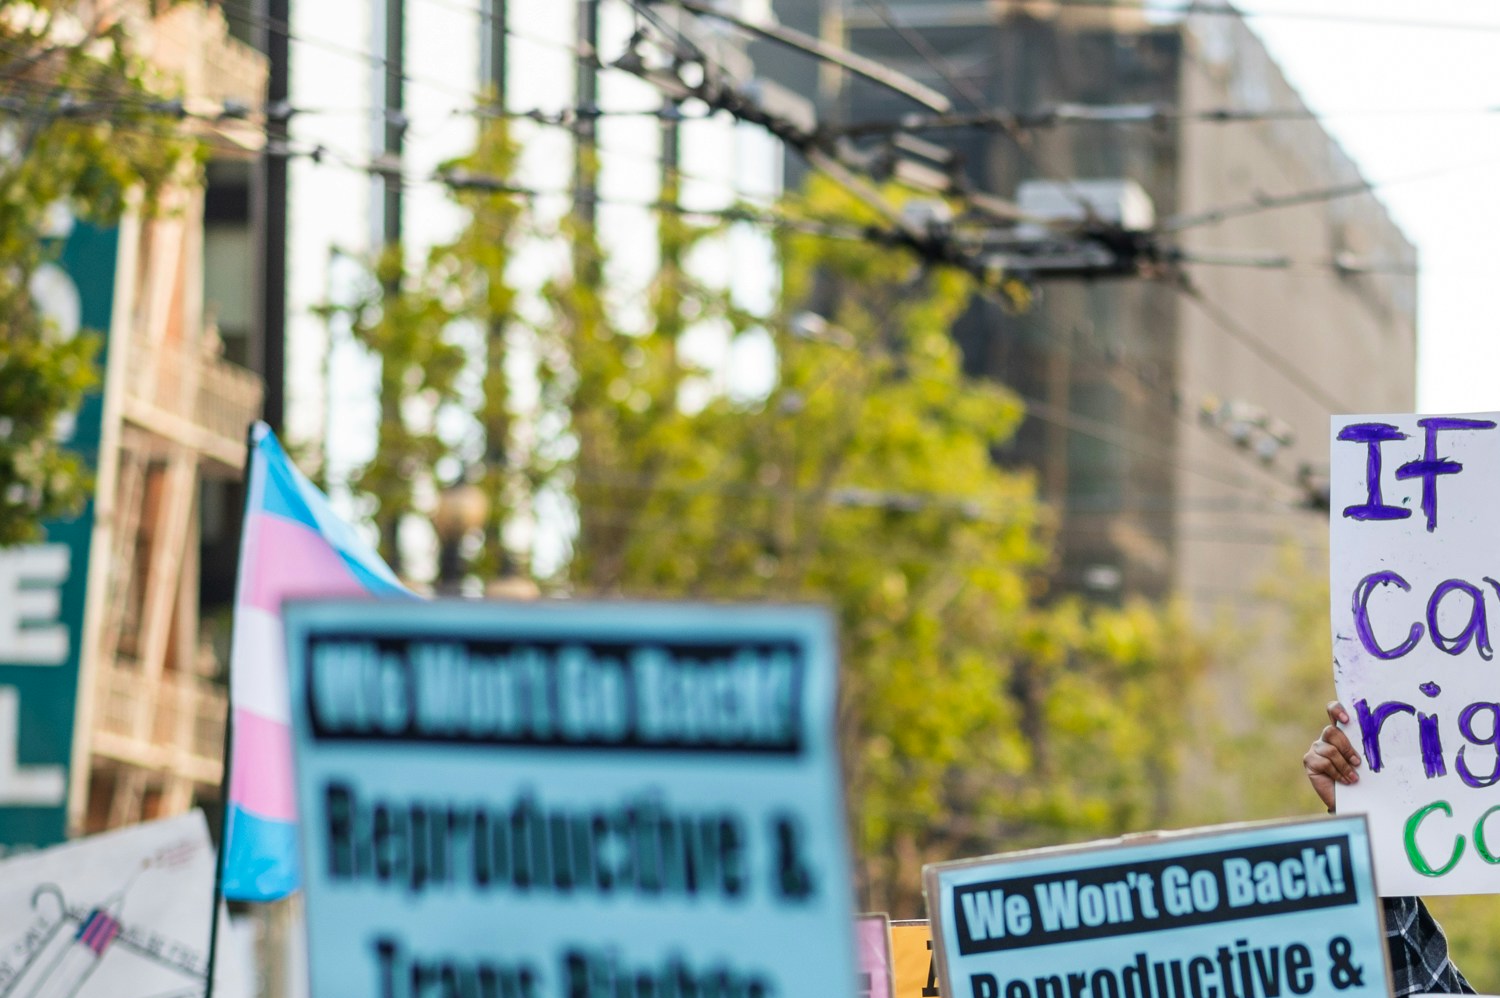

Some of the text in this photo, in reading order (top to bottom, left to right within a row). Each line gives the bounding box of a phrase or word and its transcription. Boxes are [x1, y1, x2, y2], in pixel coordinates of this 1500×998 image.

[1337, 417, 1497, 532] IF
[320, 778, 748, 897] Reproductive
[961, 844, 1345, 942] We Won't Go Back!
[1327, 935, 1366, 991] &
